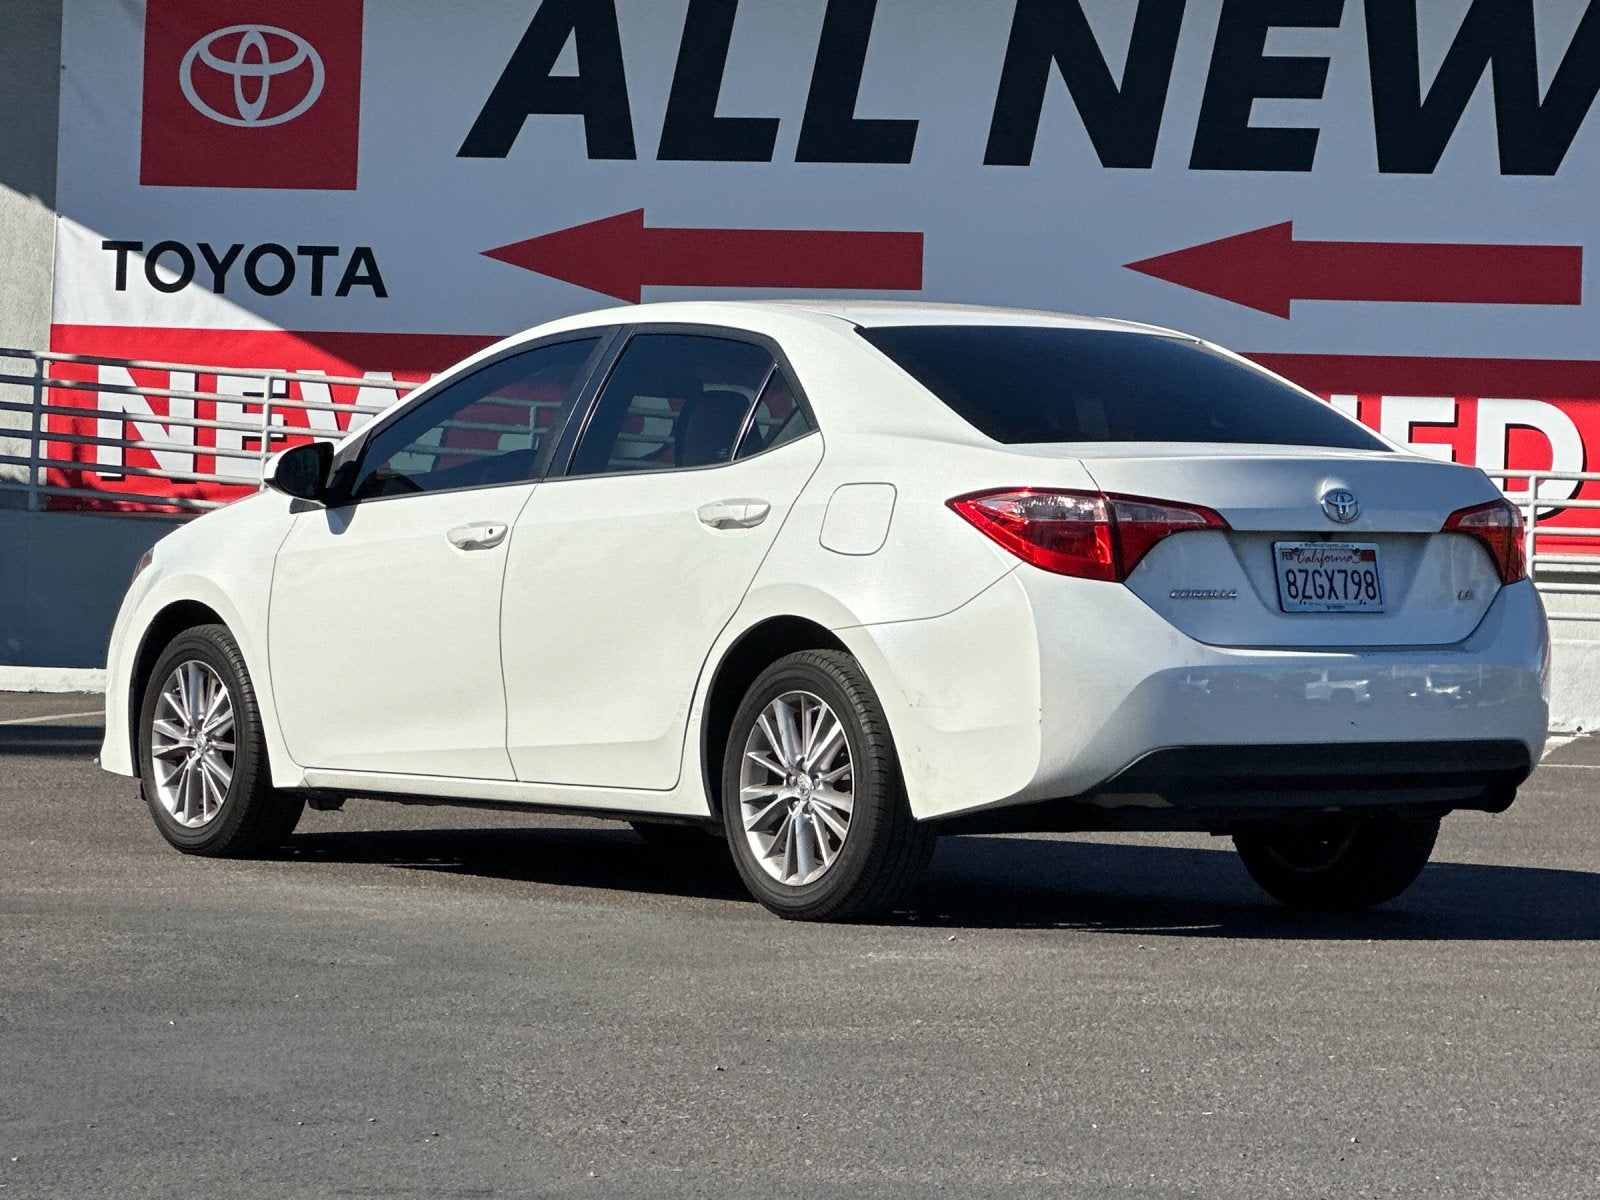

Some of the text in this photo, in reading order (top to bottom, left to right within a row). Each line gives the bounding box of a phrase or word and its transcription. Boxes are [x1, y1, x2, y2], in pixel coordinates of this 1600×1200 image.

[456, 0, 1600, 177] ALL NEW
[101, 240, 388, 298] TOYOTA
[1296, 549, 1354, 568] California
[1285, 569, 1377, 600] 8ZGX798
